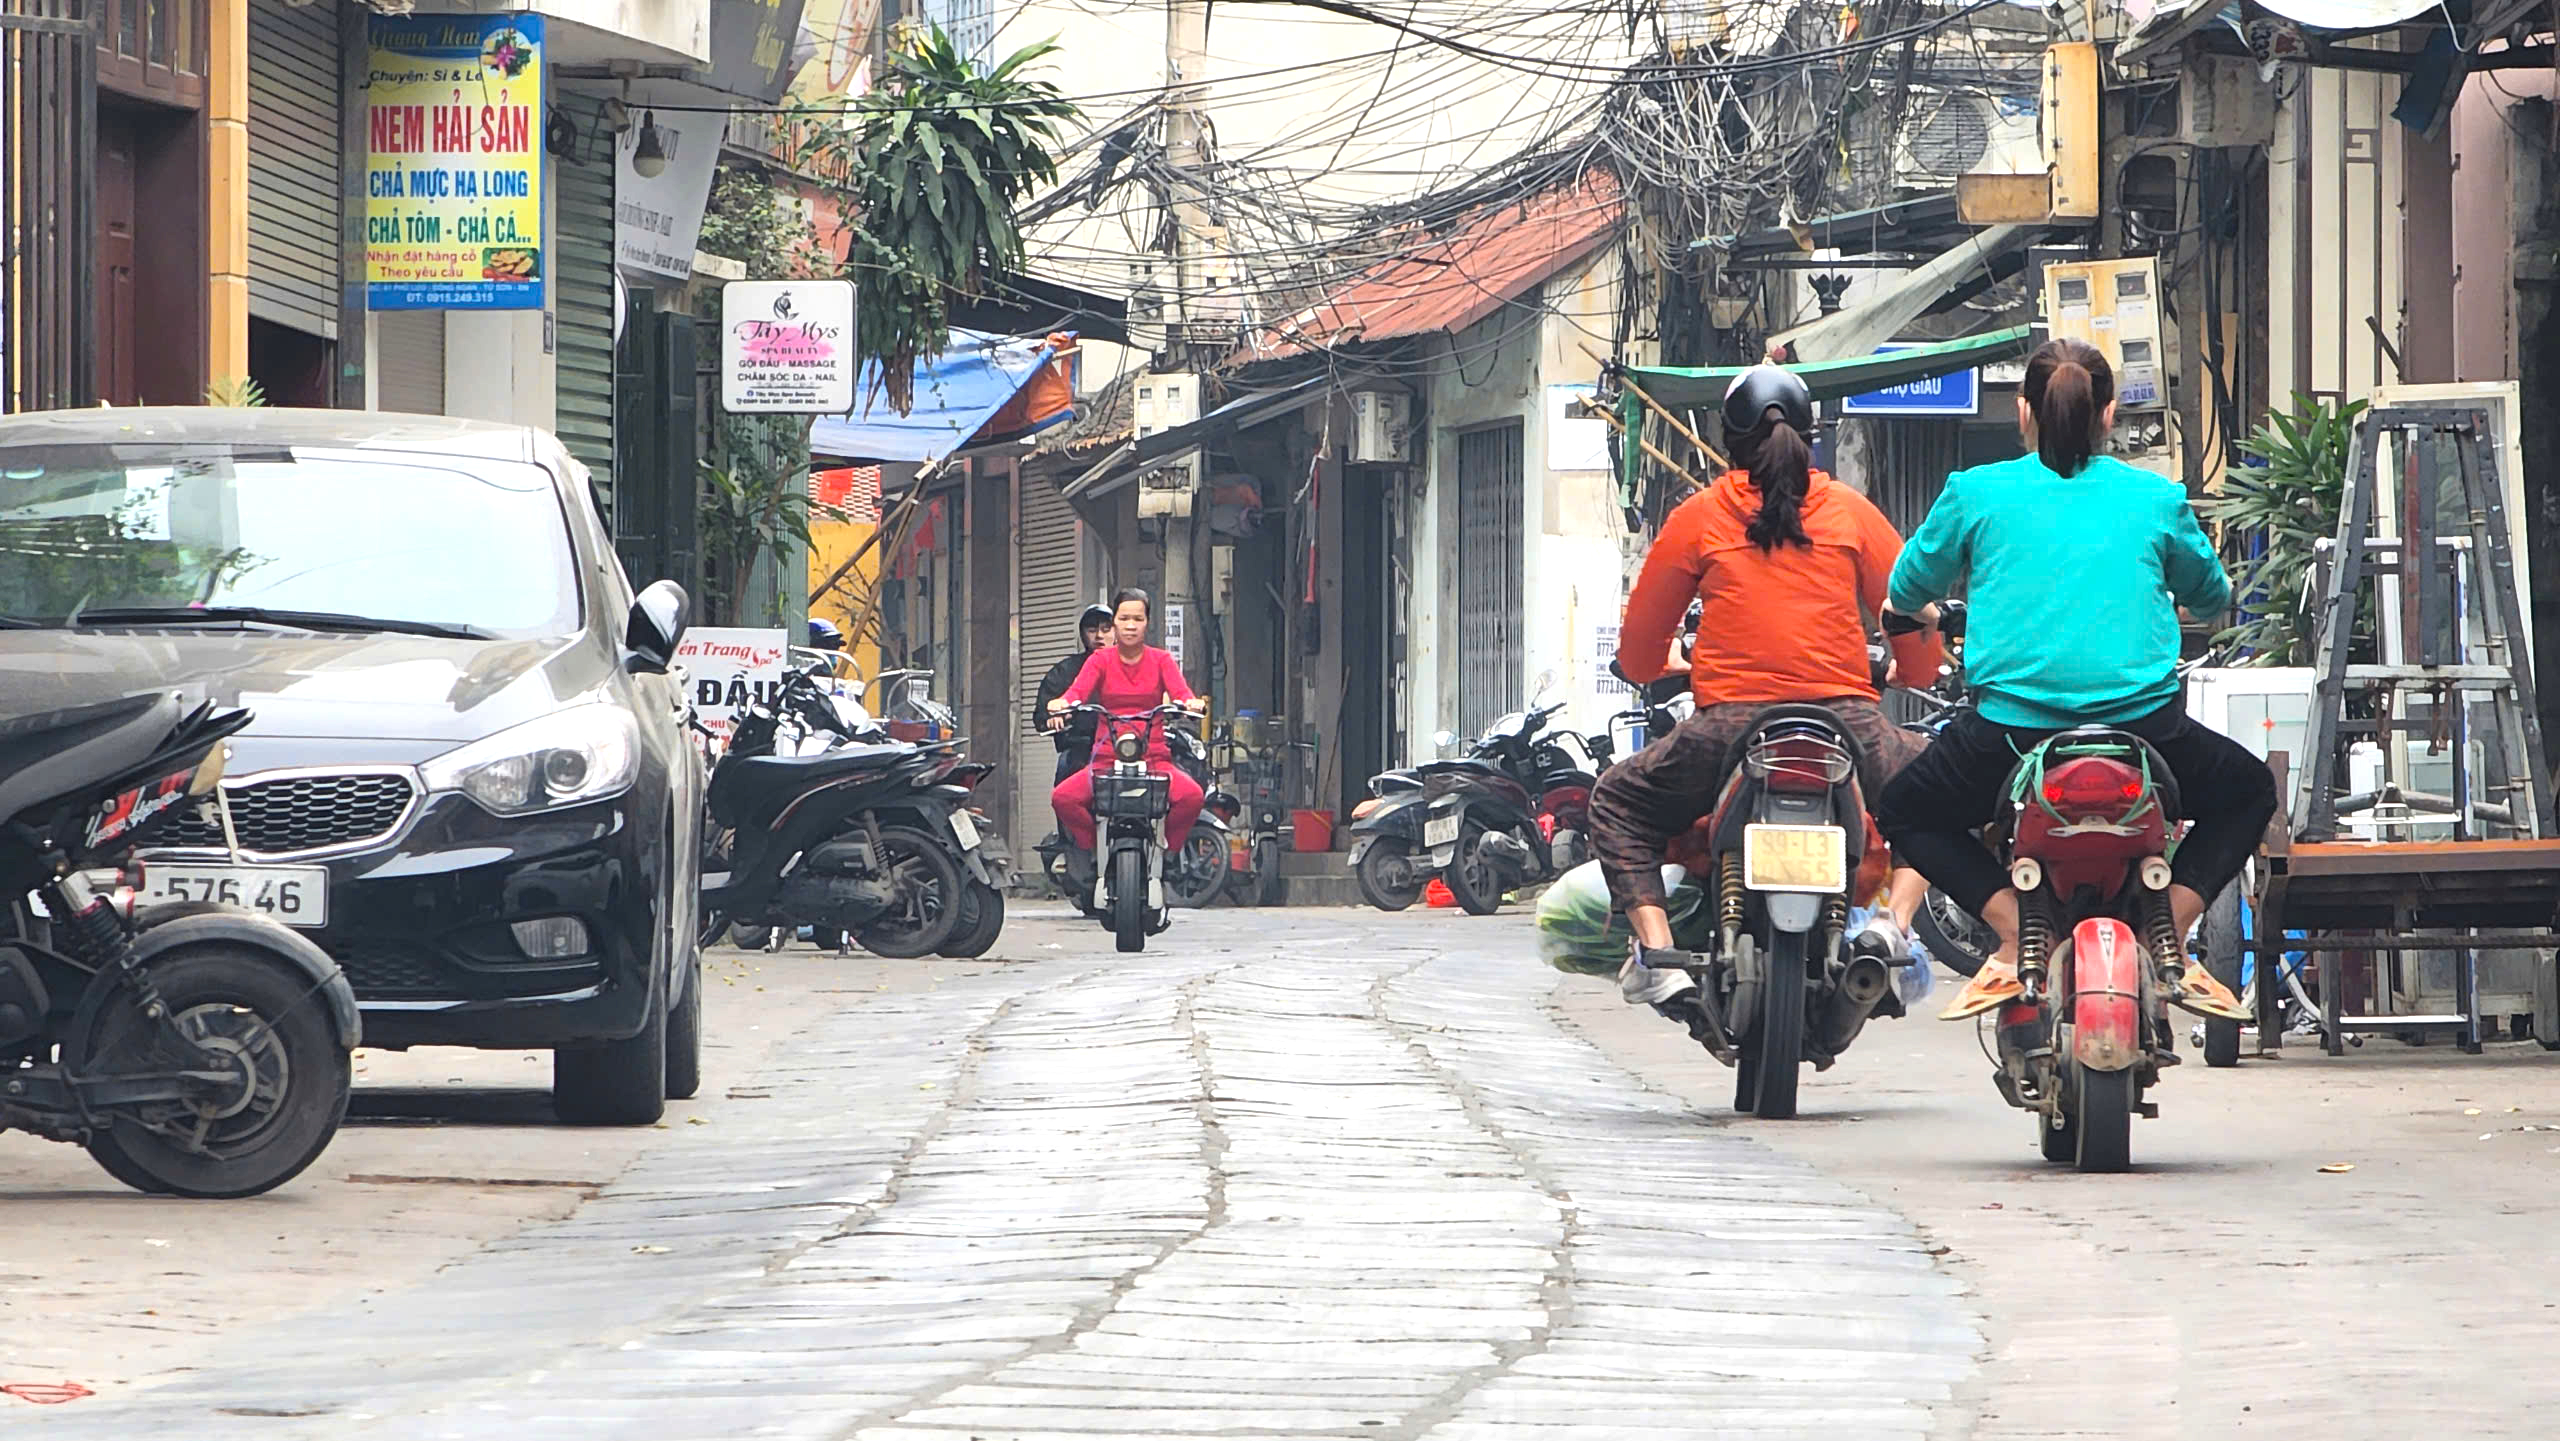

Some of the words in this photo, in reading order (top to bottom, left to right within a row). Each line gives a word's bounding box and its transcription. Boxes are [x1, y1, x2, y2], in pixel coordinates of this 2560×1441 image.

[452, 71, 461, 81] &
[371, 106, 424, 153] NEM
[433, 88, 471, 153] HẢI
[480, 88, 529, 153] SẢN
[370, 161, 404, 197] CHẢ
[410, 168, 449, 203] MỰC
[455, 170, 477, 203] HẠ
[483, 170, 528, 197] LONG
[368, 207, 401, 243] CHẢ
[405, 210, 440, 243] TÔM
[457, 207, 490, 243] CHẢ
[380, 266, 411, 277] Theo
[789, 360, 837, 368] MASSAGE
[737, 372, 766, 381] CHĂM
[770, 372, 790, 381] SÓC
[793, 373, 806, 381] DA
[815, 373, 837, 381] NAIL
[703, 642, 752, 659] Trang
